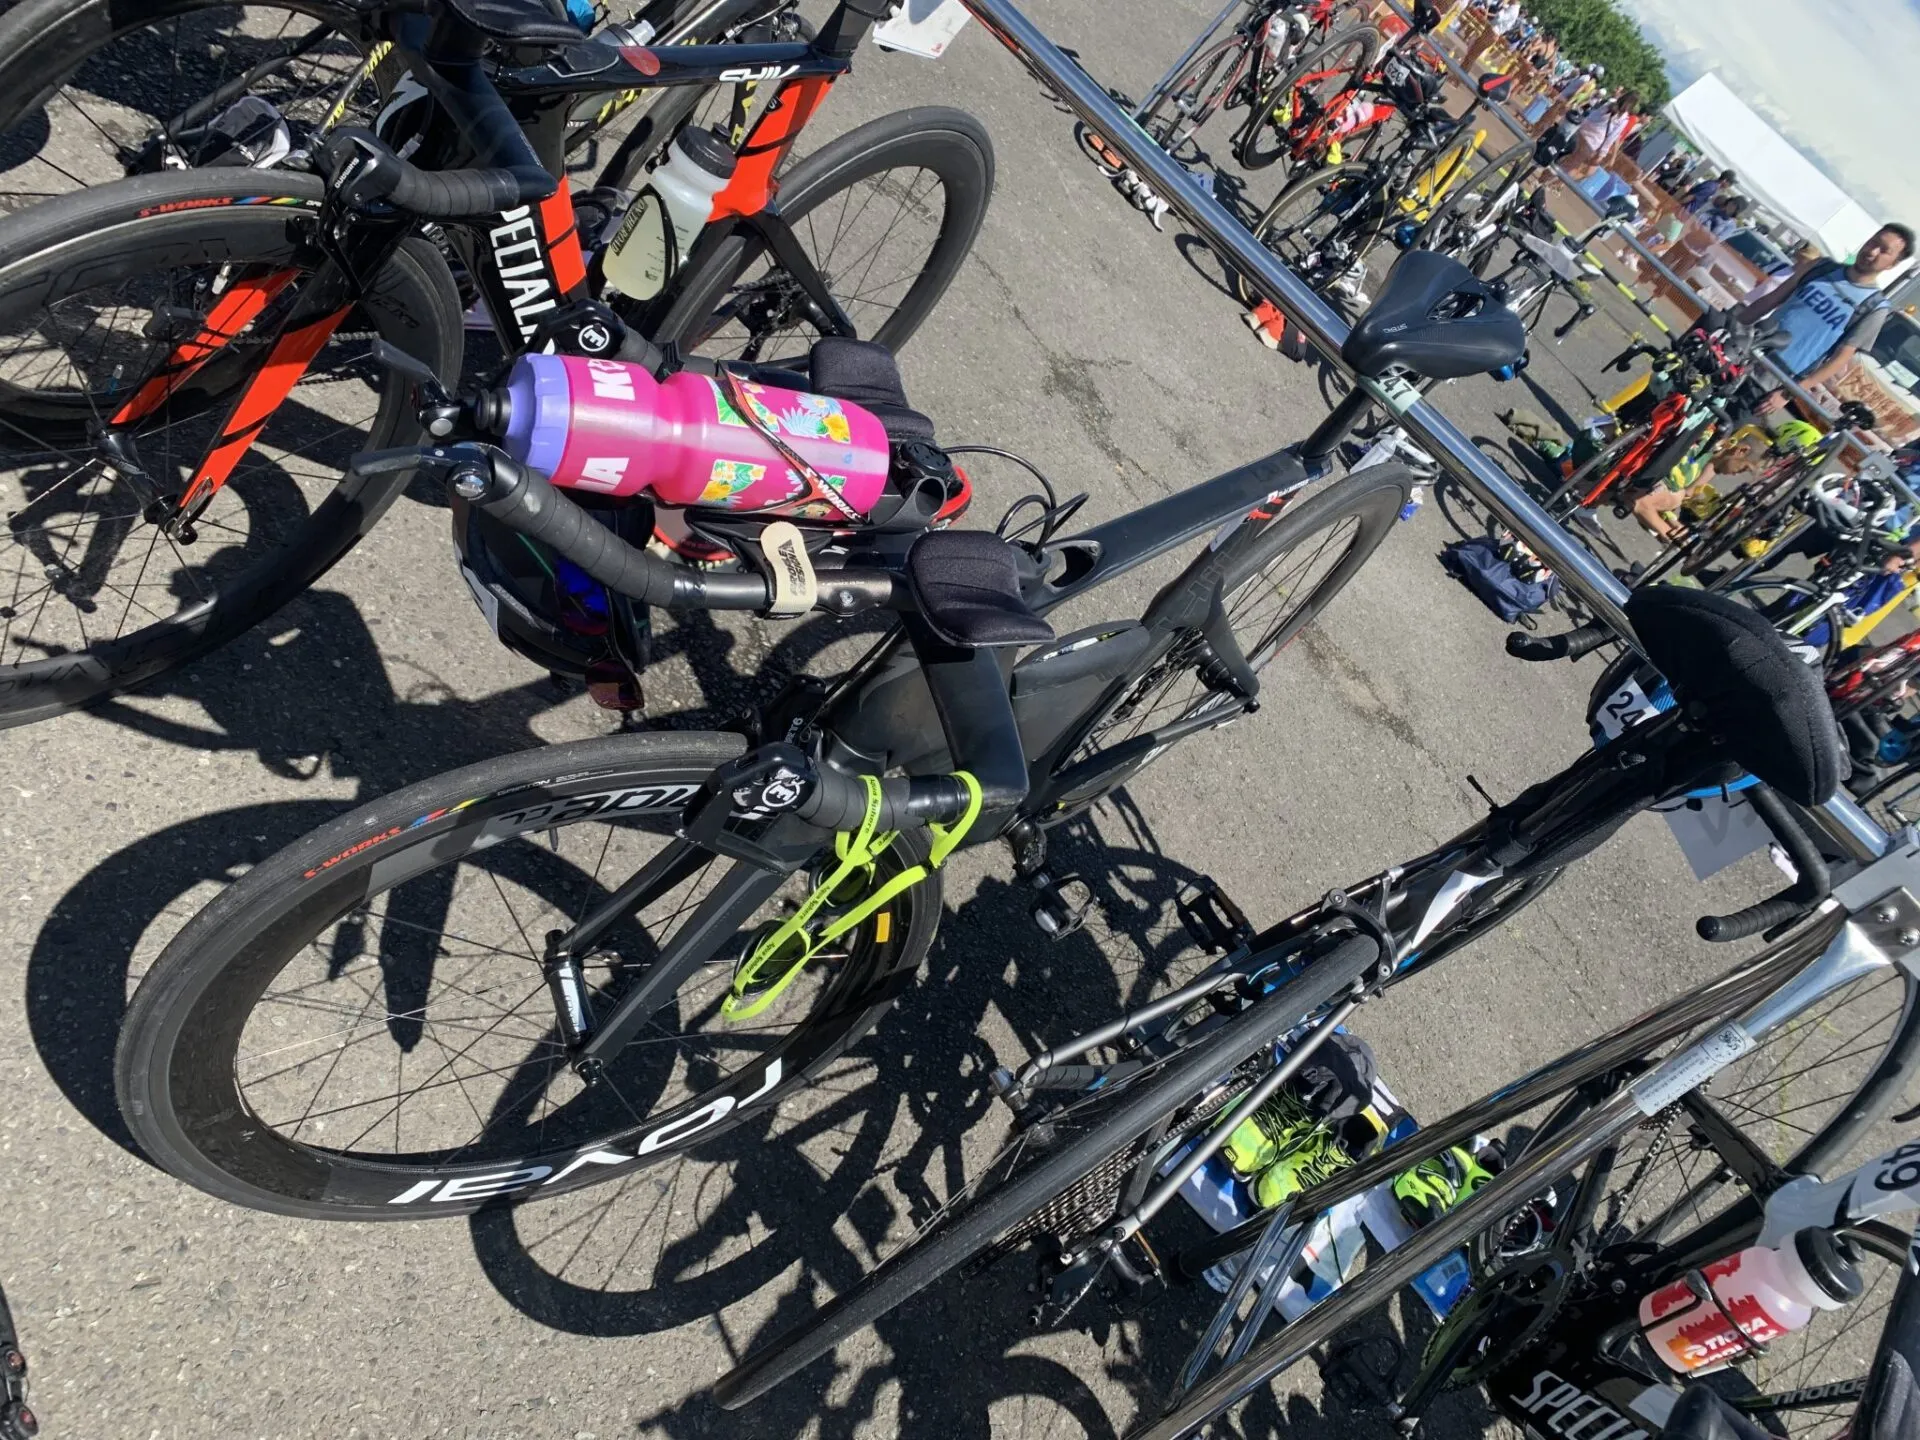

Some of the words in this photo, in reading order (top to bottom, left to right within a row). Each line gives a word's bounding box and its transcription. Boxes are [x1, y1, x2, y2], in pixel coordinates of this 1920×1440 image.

[334, 157, 360, 189] SHIMANO
[1375, 377, 1412, 401] 47
[804, 467, 861, 520] S-WORKS
[866, 799, 879, 834] Sphere
[303, 826, 401, 880] S-WORKS
